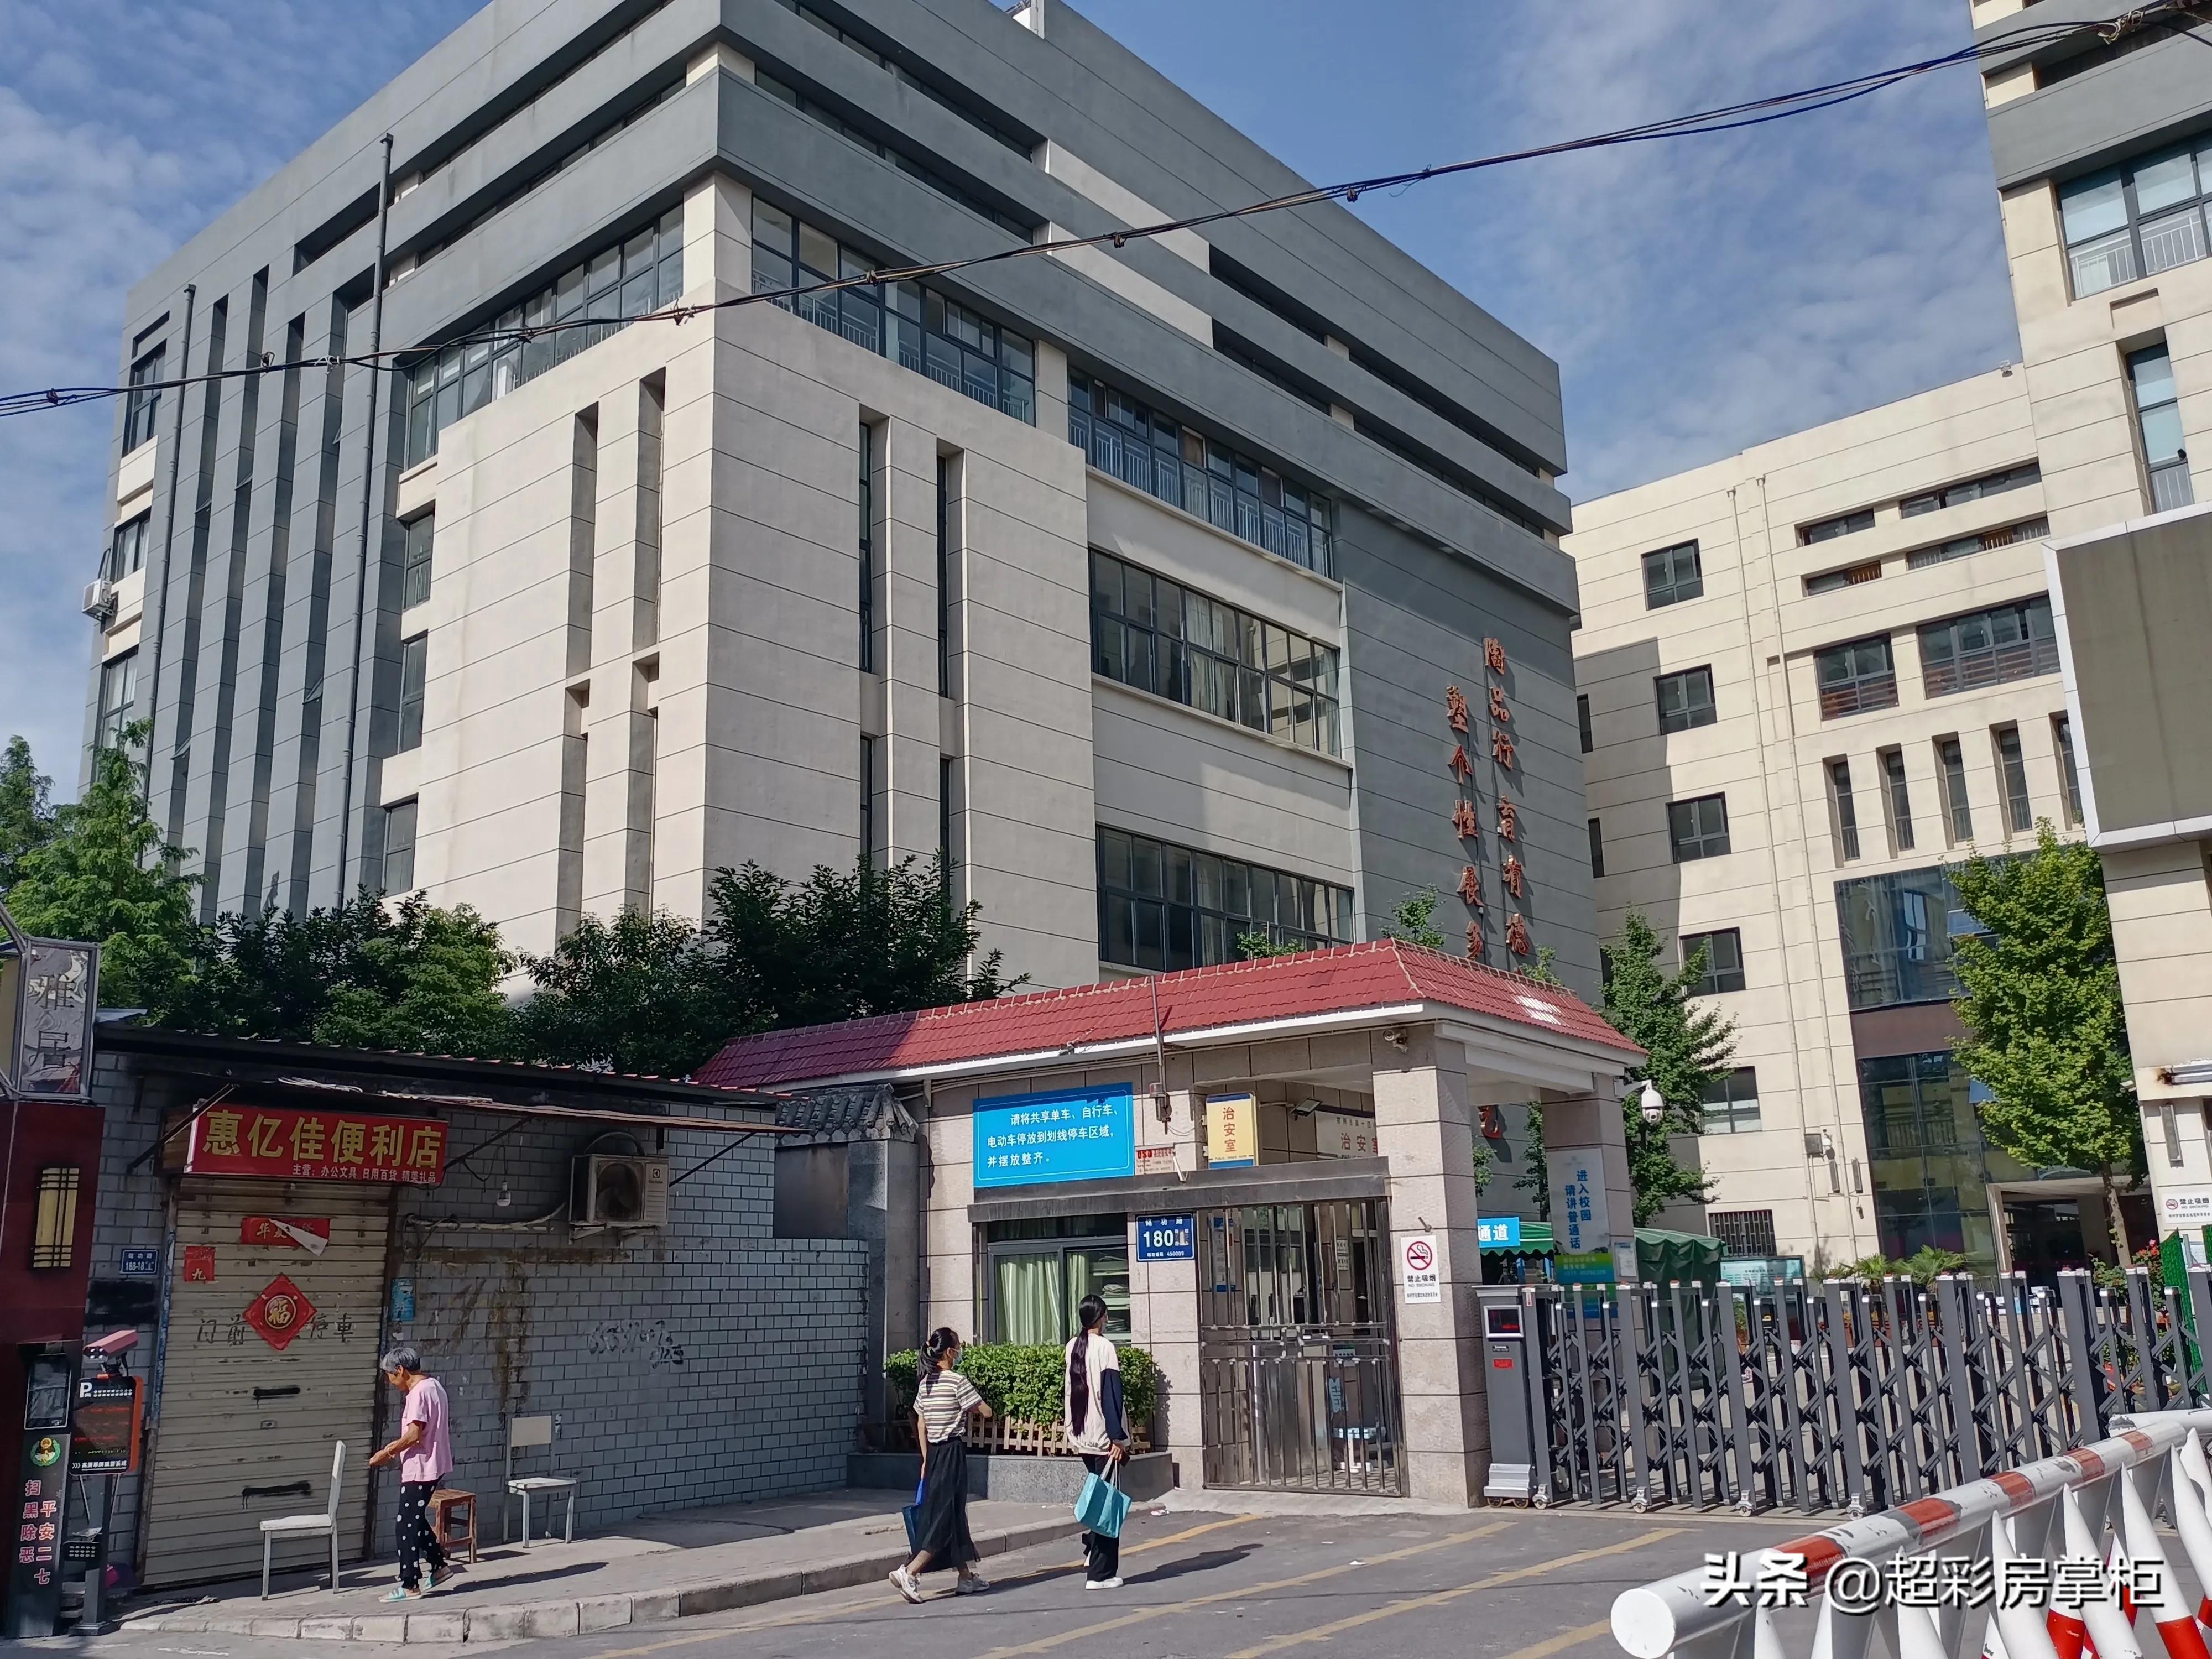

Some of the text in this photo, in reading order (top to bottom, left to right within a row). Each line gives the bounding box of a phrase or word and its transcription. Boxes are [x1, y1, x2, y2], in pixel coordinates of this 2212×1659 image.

[1010, 1104, 1118, 1126] 请将共享单车、自行车、
[202, 1109, 442, 1169] 惠亿佳便利店
[987, 1124, 1114, 1149] 电动车停放到划线停车区域，
[1223, 1106, 1237, 1152] 治安室
[987, 1151, 1050, 1168] 并摆放整齐。
[321, 1165, 357, 1178] 办公文具
[363, 1168, 398, 1182] 日用百货
[401, 1170, 436, 1183] 精美礼品
[1576, 1170, 1592, 1222] 进入校园
[1564, 1185, 1581, 1249] 请讲普通话
[1143, 1229, 1174, 1248] 180
[1478, 1223, 1509, 1241] 通道
[1407, 1274, 1436, 1282] 禁止吸烟
[268, 1298, 291, 1324] 福
[19, 1479, 42, 1564] 扫黑除恶
[34, 1500, 57, 1585] 平安二七
